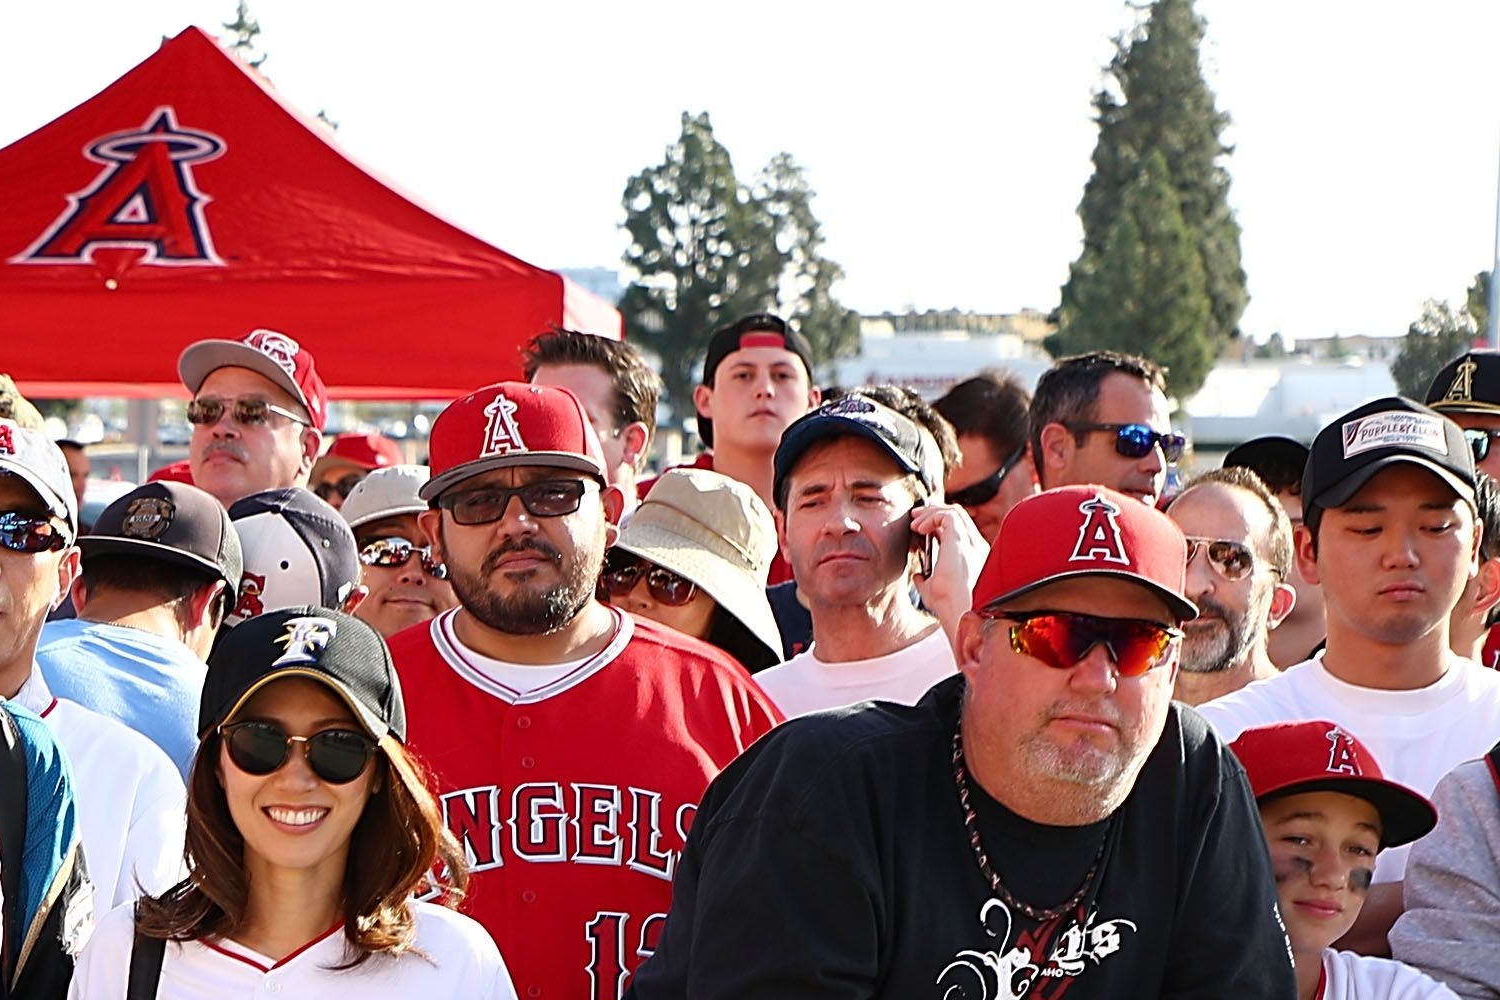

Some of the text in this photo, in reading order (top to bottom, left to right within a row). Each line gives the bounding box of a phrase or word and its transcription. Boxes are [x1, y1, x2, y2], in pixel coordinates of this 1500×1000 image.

[7, 106, 229, 266] A
[480, 394, 528, 456] A
[1068, 495, 1132, 566] A
[1326, 726, 1361, 777] A
[413, 782, 698, 901] NGEL
